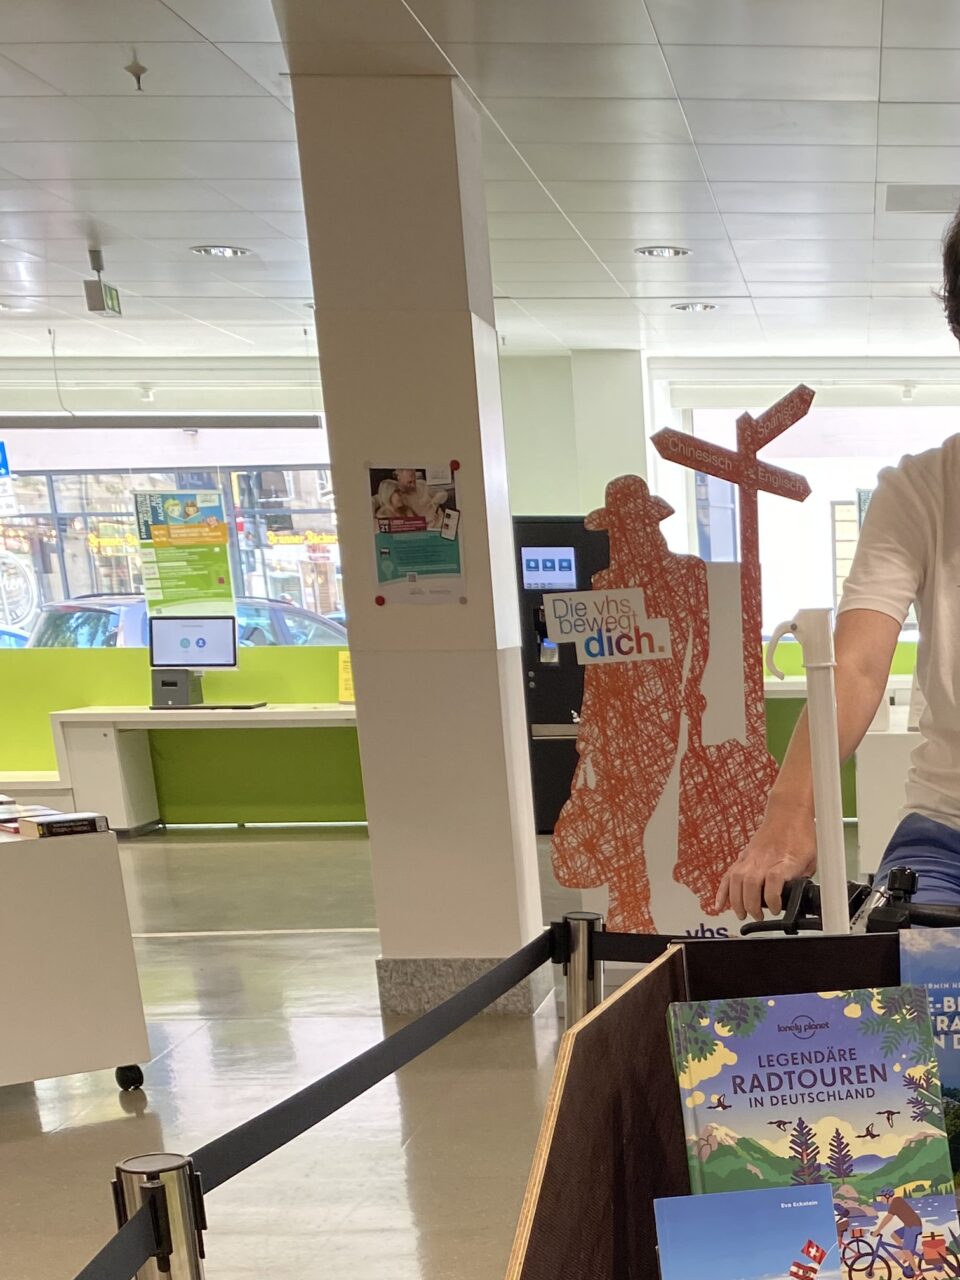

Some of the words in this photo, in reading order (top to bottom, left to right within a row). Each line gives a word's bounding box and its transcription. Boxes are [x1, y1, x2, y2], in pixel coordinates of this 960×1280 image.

[758, 398, 802, 438] Spanisch
[669, 436, 733, 471] Chinesisch
[758, 467, 803, 492] Englisch
[552, 598, 587, 619] Die
[594, 595, 632, 616] vhs
[559, 610, 638, 635] bewegt
[584, 624, 665, 658] dich.
[758, 1048, 857, 1068] LEGENDÄRE
[732, 1063, 888, 1095] RADTOUREN
[749, 1097, 764, 1109] IN
[770, 1087, 875, 1106] DEUTSCHLAND
